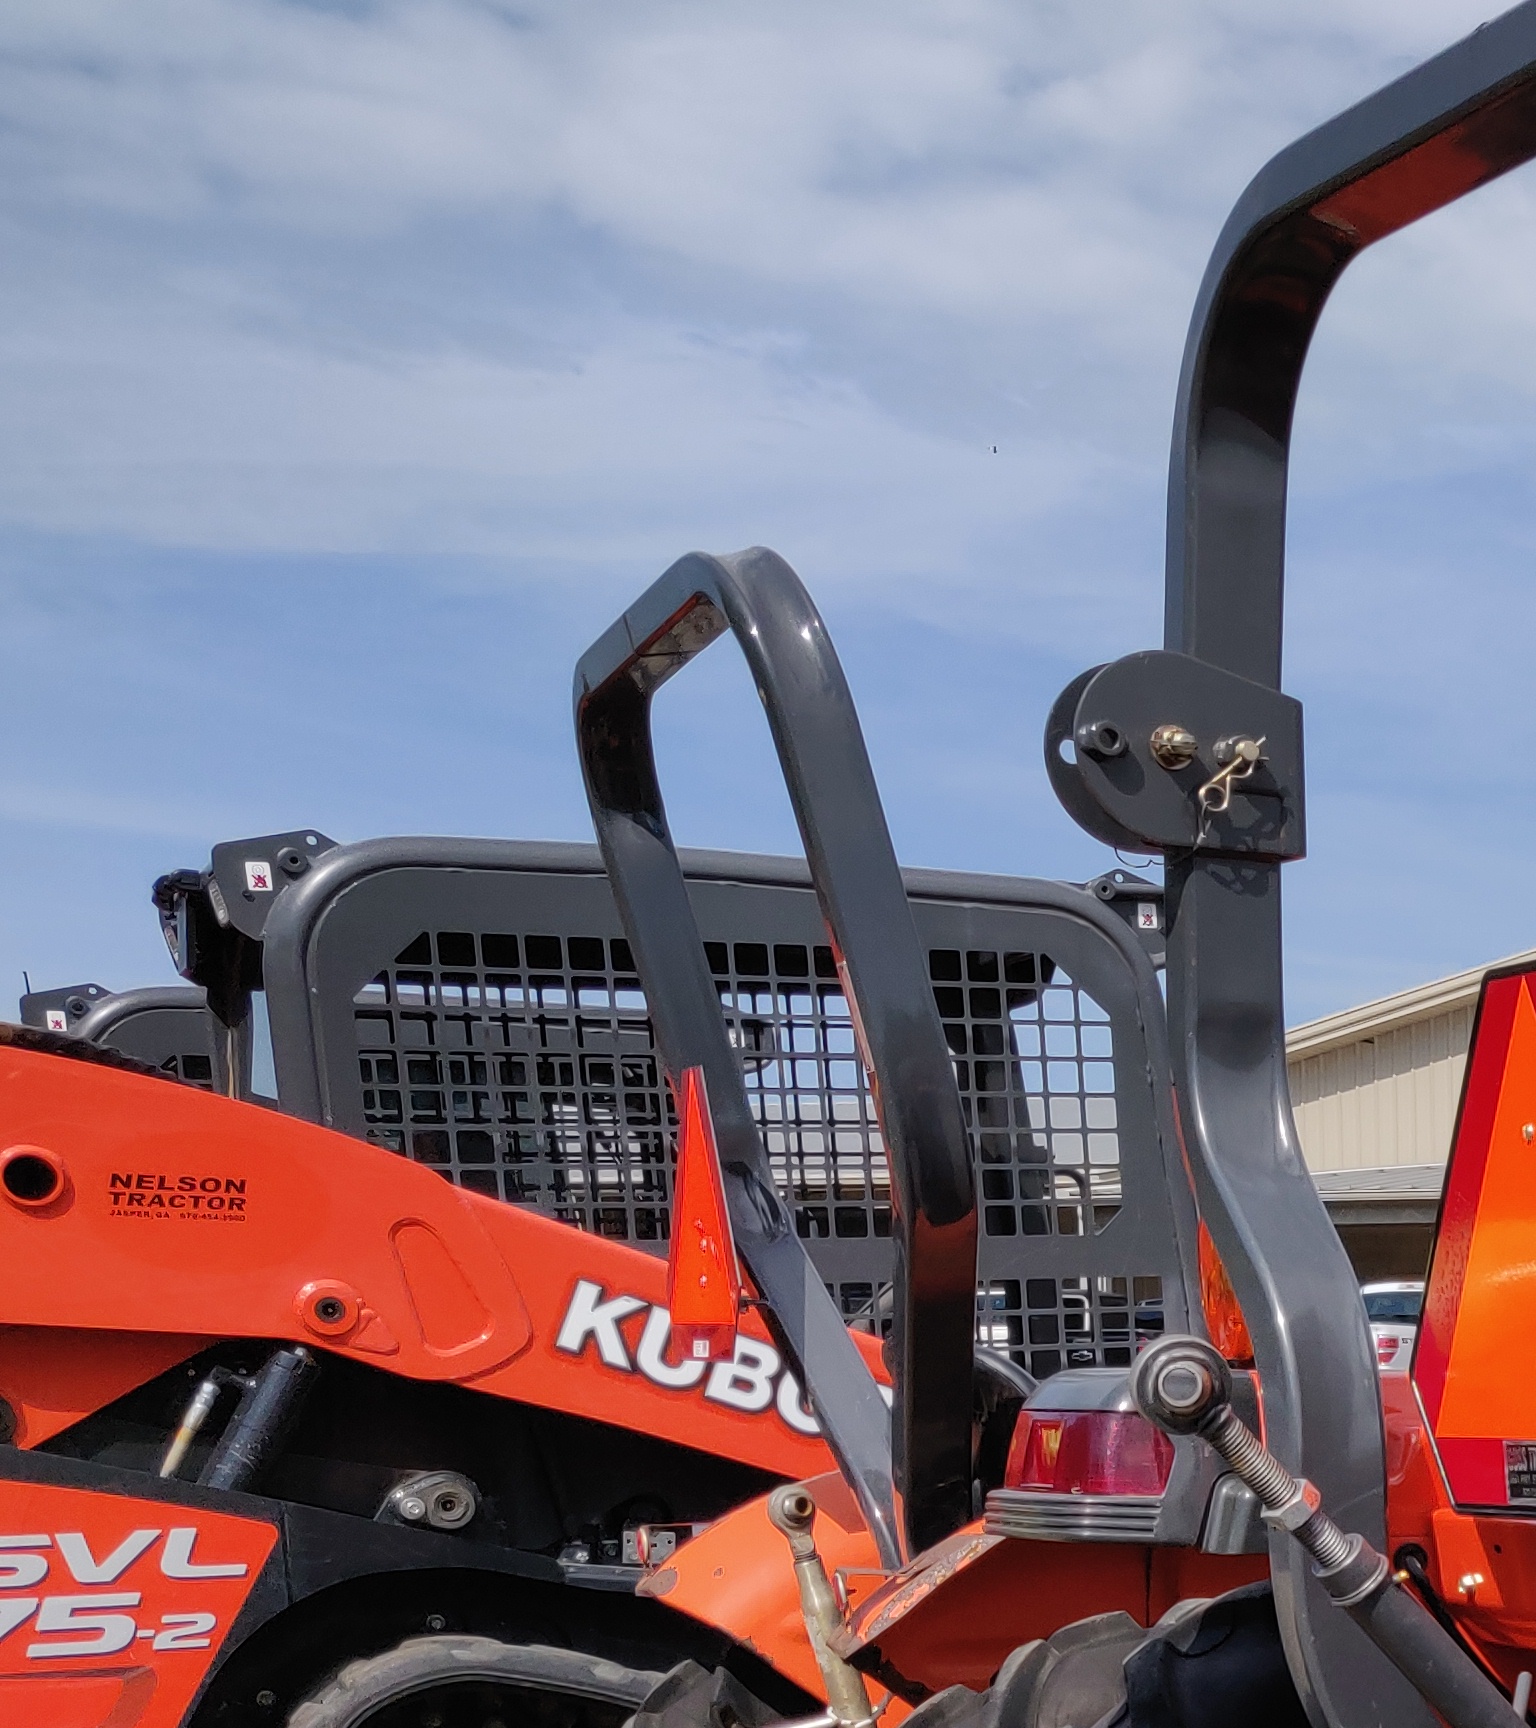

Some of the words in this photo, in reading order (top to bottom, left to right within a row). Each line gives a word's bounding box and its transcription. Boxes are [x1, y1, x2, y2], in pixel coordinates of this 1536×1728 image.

[109, 1173, 247, 1194] NELSON
[108, 1191, 247, 1211] TRACTOR
[555, 1278, 893, 1435] KUBO
